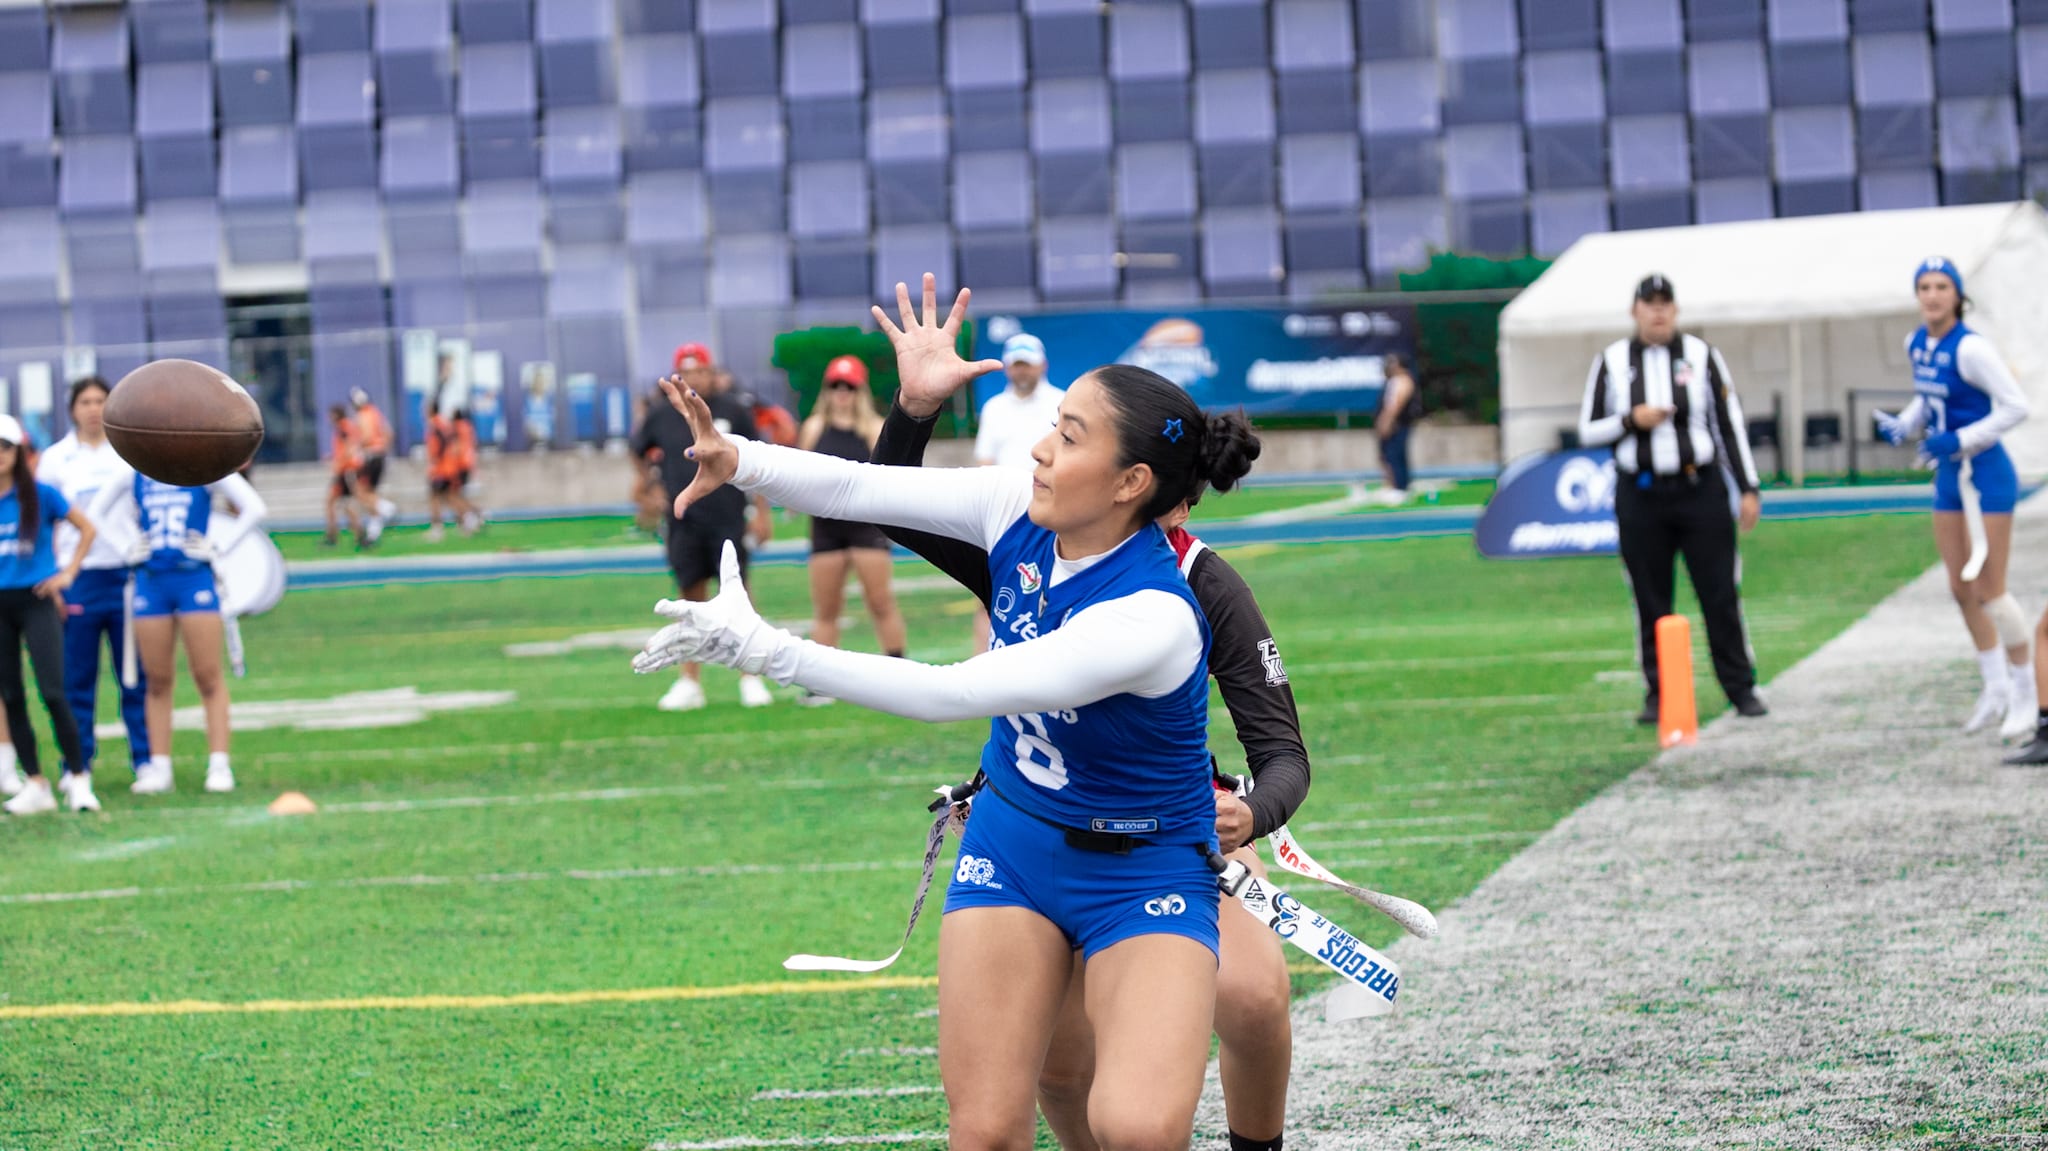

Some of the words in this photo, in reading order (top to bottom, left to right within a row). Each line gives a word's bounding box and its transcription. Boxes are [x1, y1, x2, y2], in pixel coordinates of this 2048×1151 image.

[148, 509, 188, 549] 25
[1010, 611, 1037, 640] te
[1280, 839, 1311, 874] SUR
[1311, 915, 1327, 929] FE
[1328, 925, 1360, 950] SANTA
[1317, 937, 1399, 1003] RREGOS
